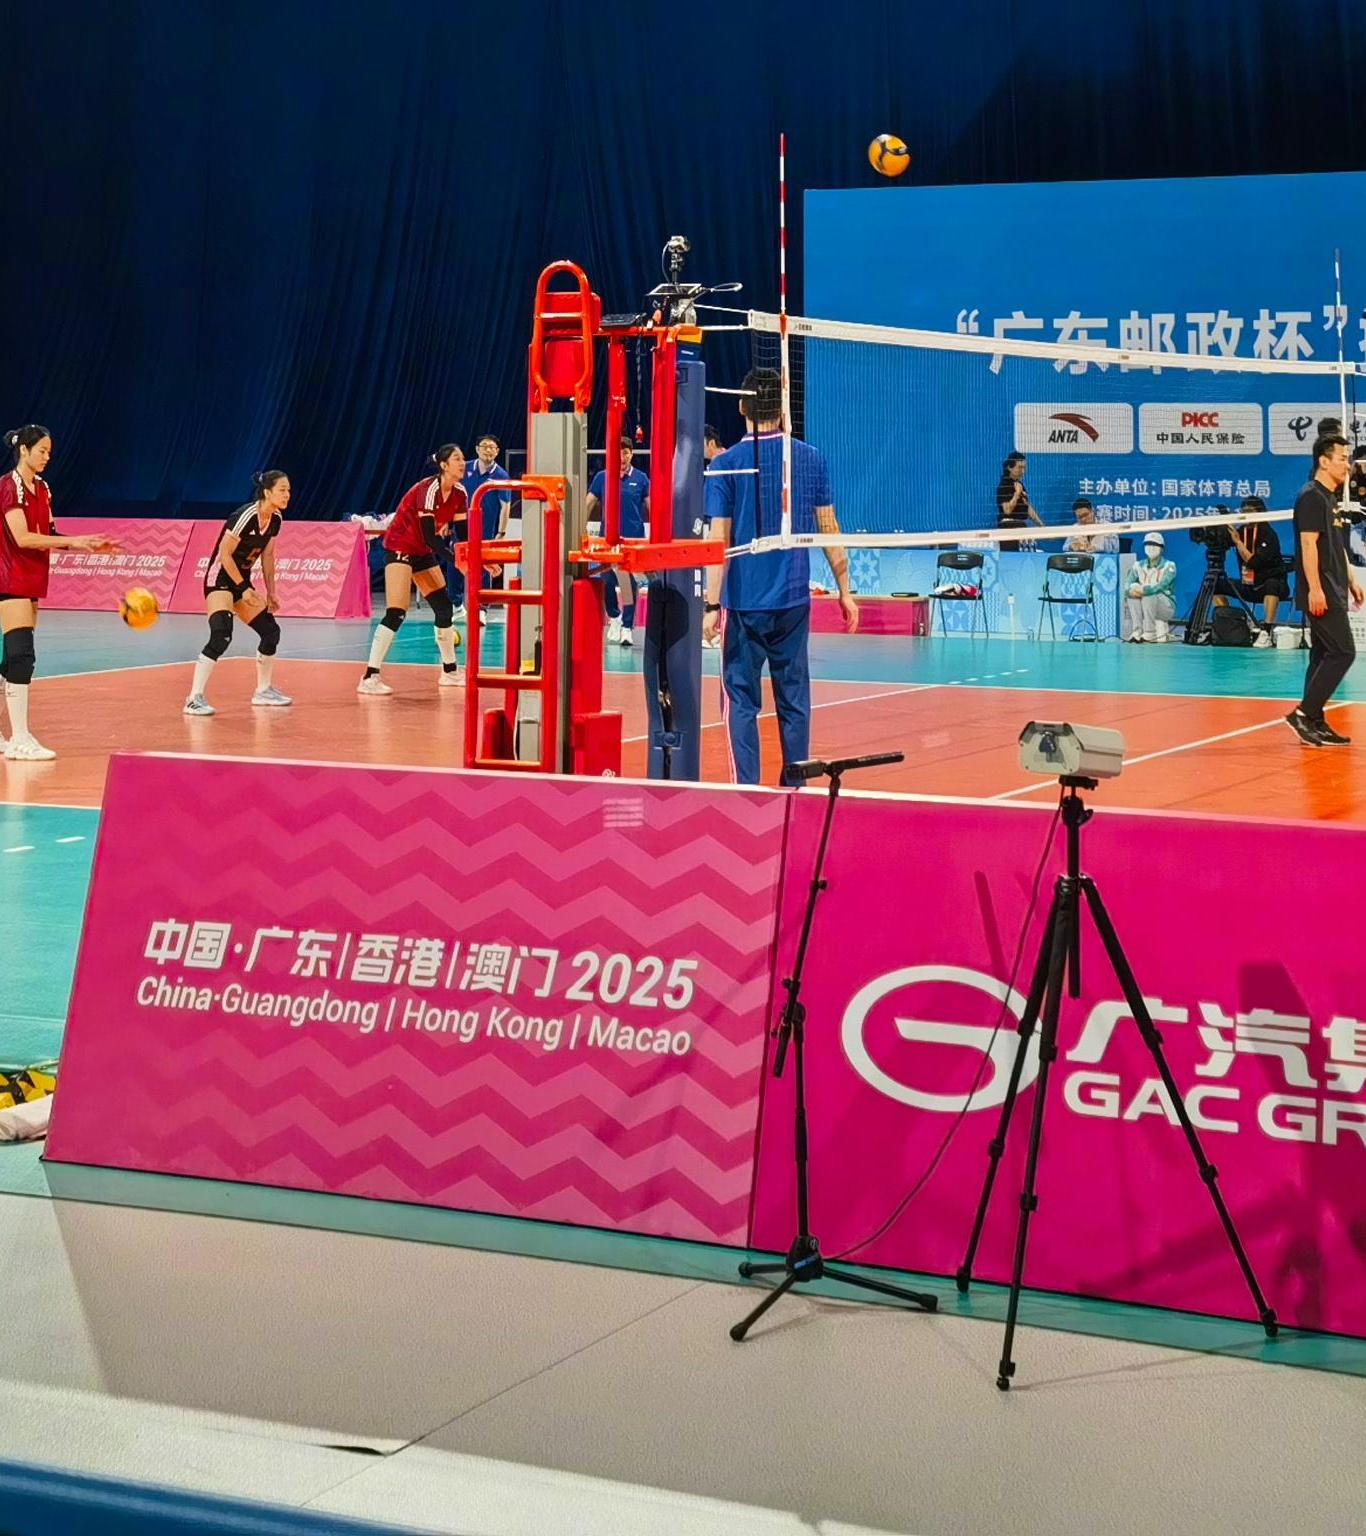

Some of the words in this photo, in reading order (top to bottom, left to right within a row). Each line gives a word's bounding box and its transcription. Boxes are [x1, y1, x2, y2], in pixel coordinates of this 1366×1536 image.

[1047, 429, 1079, 444] ANTA
[1156, 431, 1246, 445] 中国人民保险
[1181, 411, 1219, 428] PICC
[565, 950, 698, 1010] 2025
[401, 999, 479, 1044] Hong
[486, 1006, 563, 1052] Kong
[587, 1015, 691, 1057] Macao
[1063, 1070, 1240, 1133] GAC
